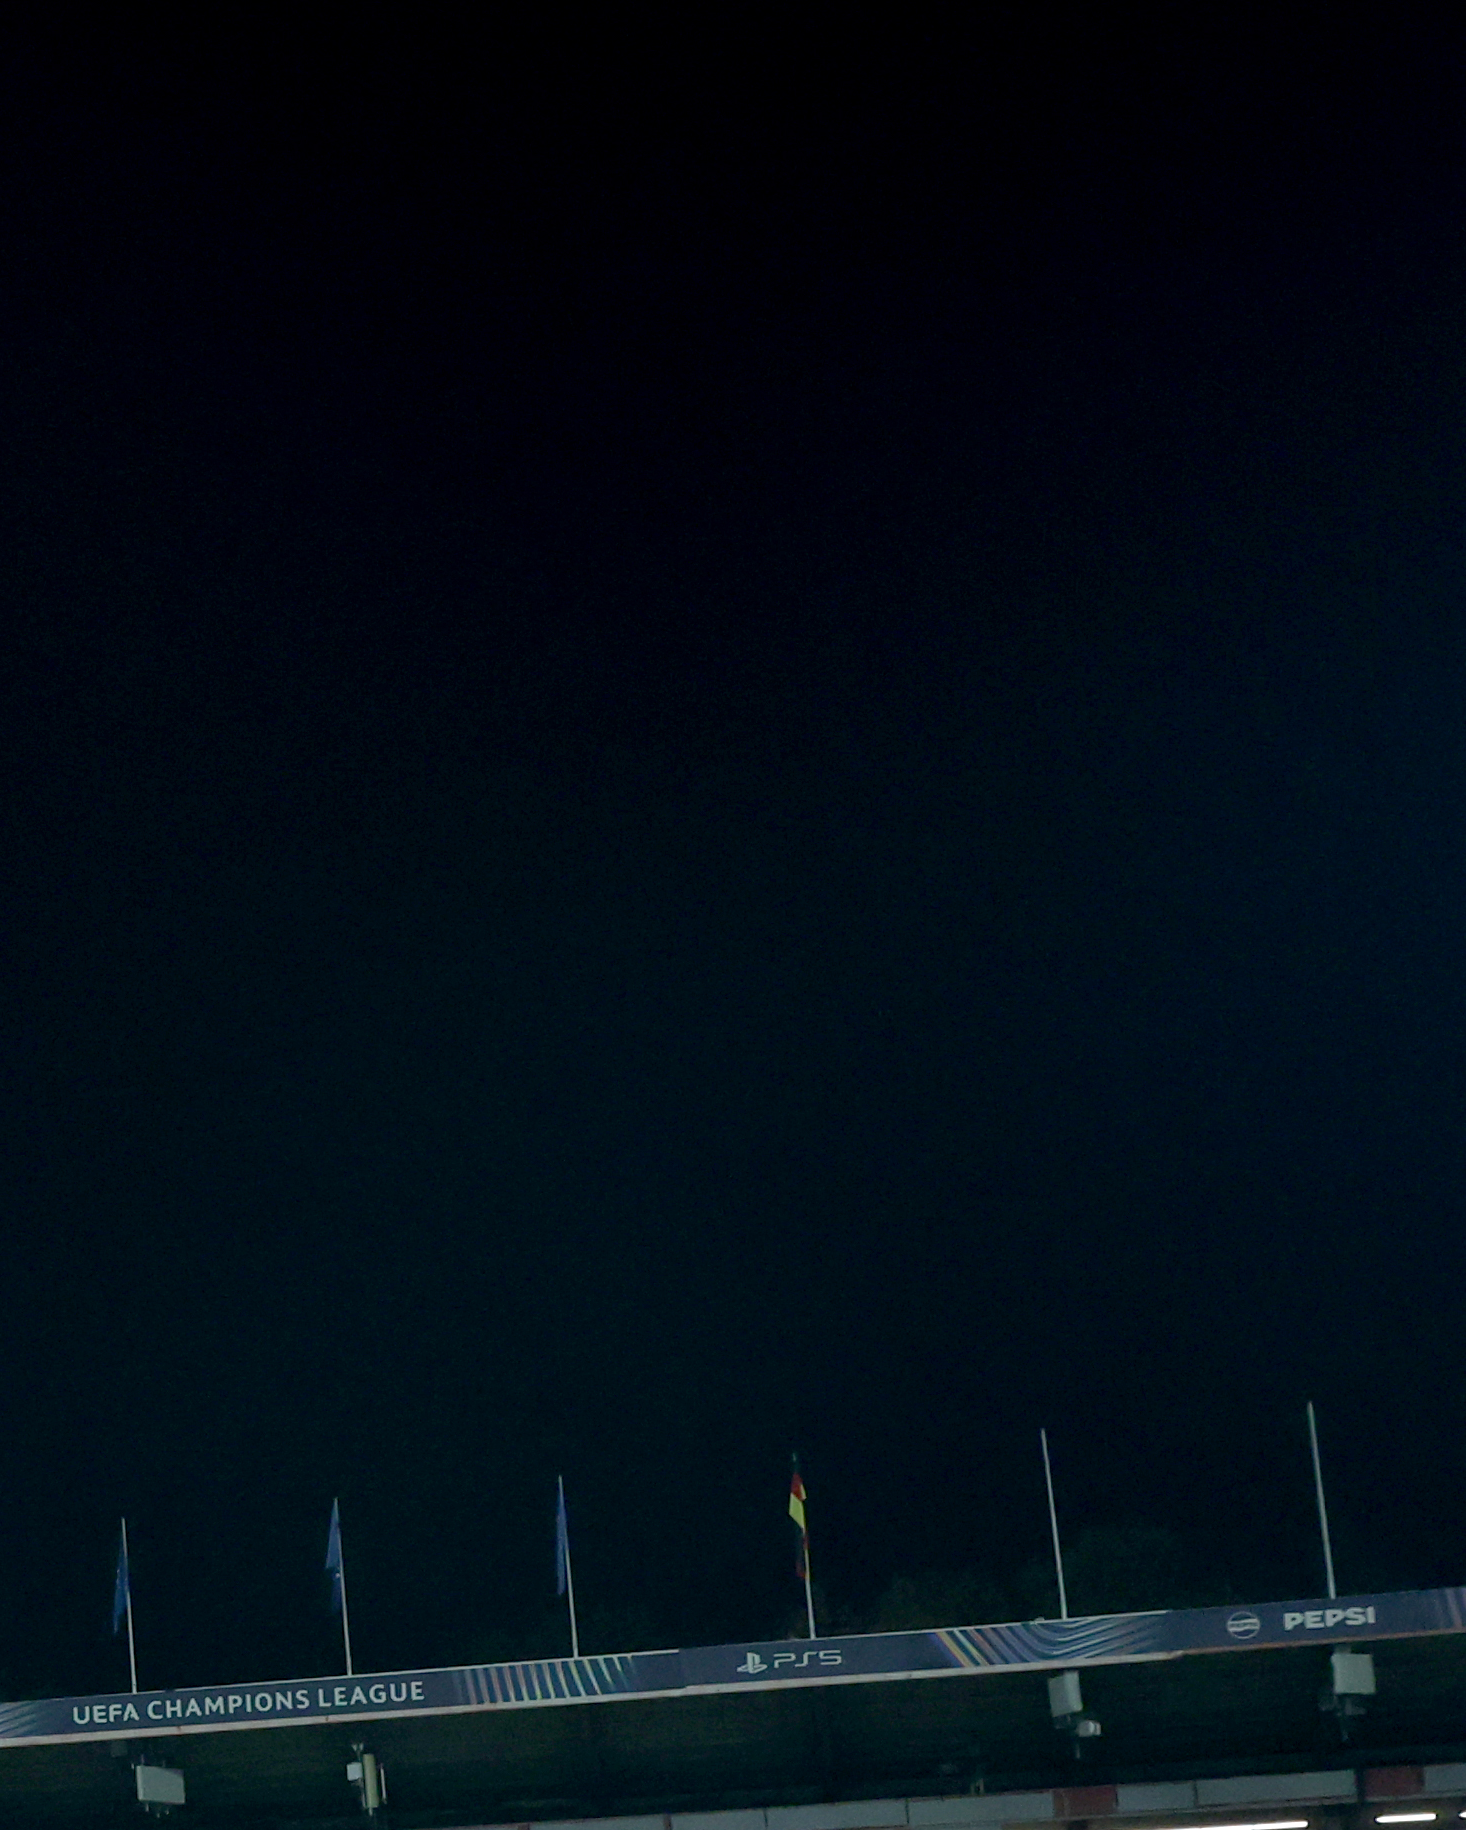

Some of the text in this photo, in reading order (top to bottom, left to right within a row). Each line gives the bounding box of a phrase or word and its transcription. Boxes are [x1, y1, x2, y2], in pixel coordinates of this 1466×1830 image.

[1284, 1606, 1376, 1631] PEPSI
[773, 1650, 842, 1669] PS5
[73, 1680, 425, 1725] UEFA CHAMPIONS LEAGUE
